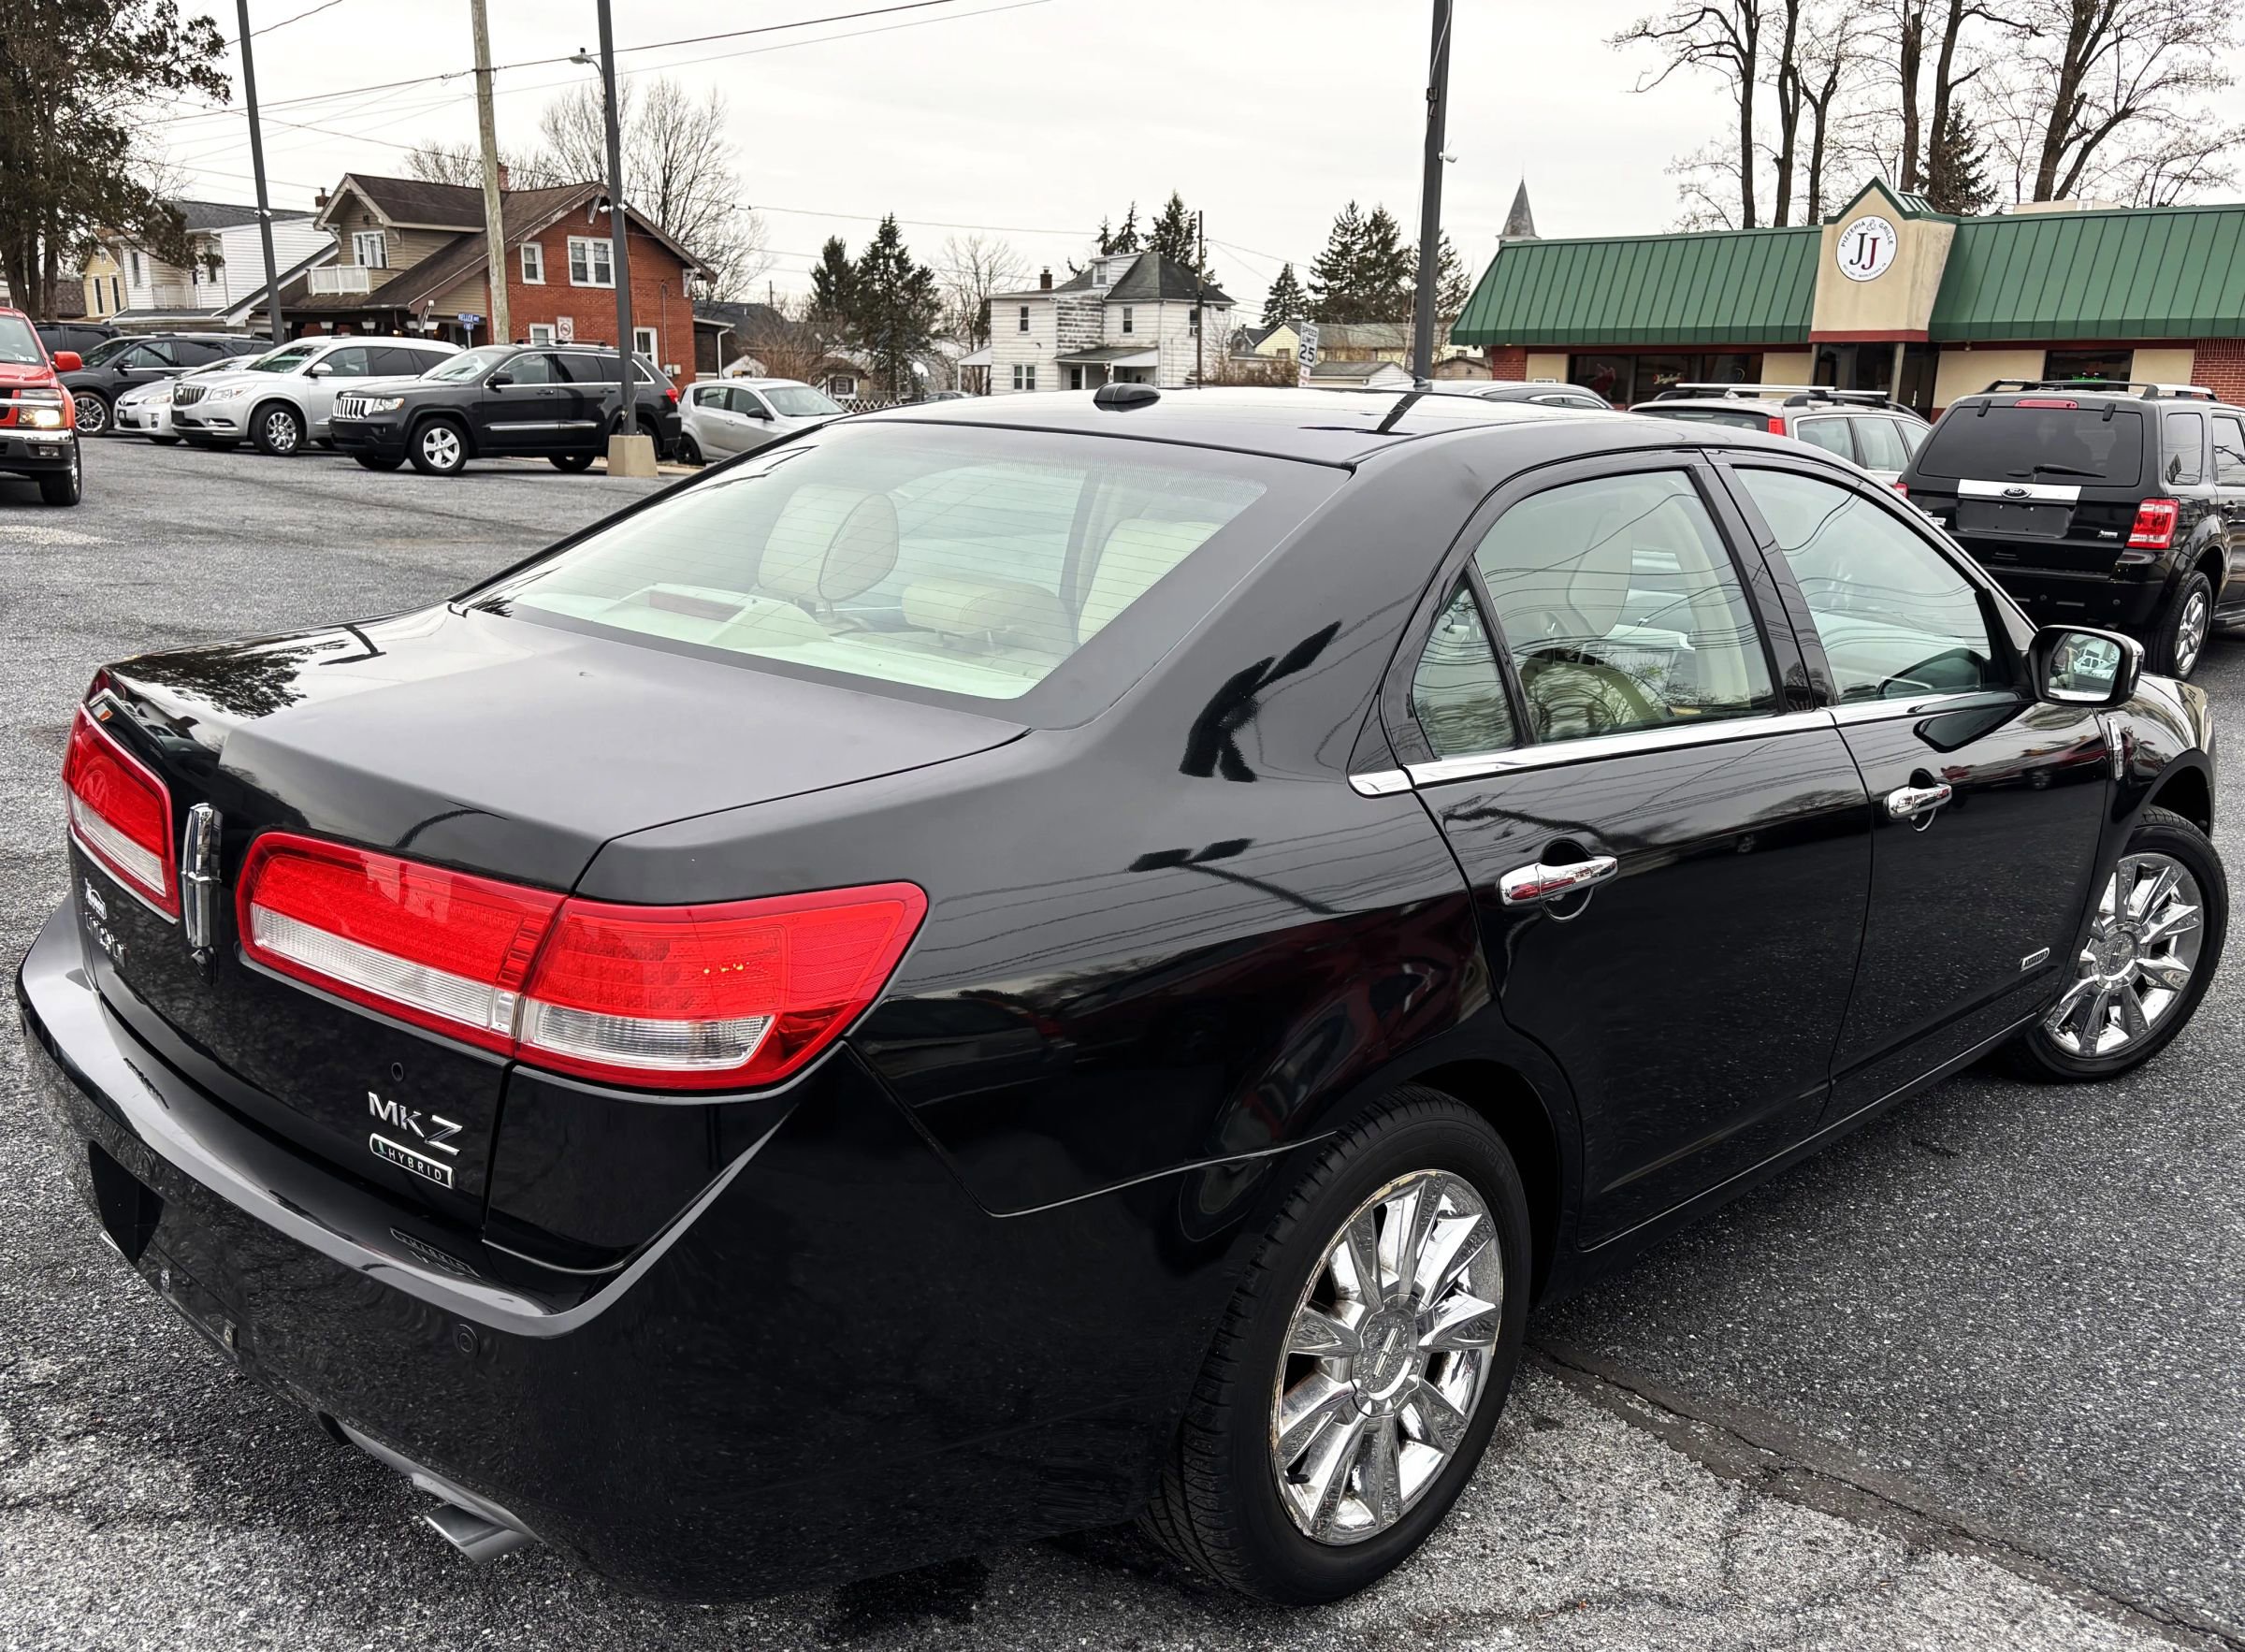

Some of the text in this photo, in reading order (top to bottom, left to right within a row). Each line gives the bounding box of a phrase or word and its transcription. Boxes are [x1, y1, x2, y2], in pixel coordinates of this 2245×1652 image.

[1841, 219, 1893, 247] PIZZERIA & GRILLE
[1302, 326, 1318, 337] SPEED
[1302, 336, 1315, 345] LIMIT
[1299, 344, 1315, 362] 25
[368, 1091, 464, 1156] MKZ
[388, 1148, 442, 1181] HYBRID
